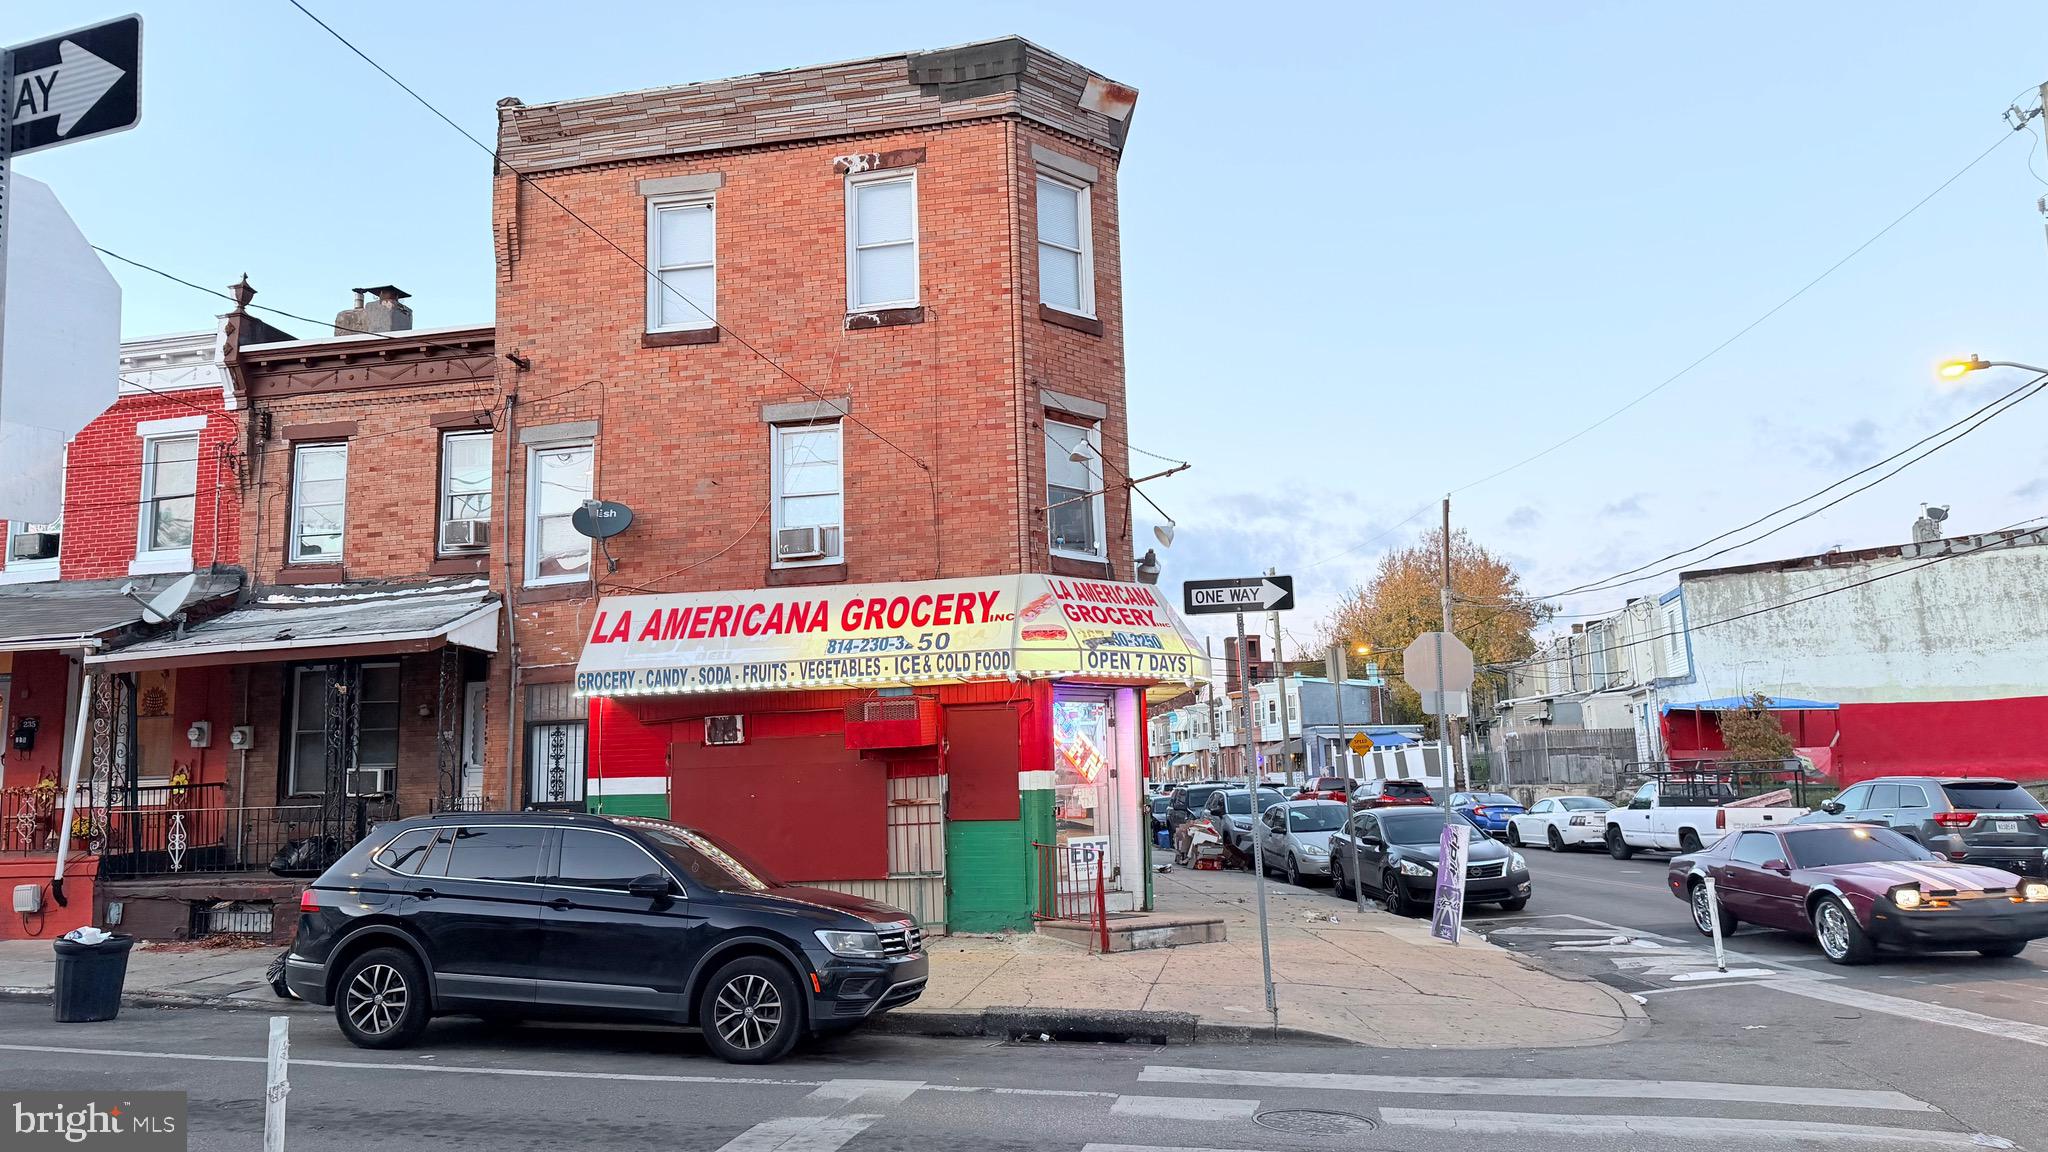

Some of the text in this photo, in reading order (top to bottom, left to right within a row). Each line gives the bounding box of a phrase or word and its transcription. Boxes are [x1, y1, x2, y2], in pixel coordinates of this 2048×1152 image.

[13, 70, 59, 120] AY
[1048, 579, 1159, 607] LA AMERICANA
[1195, 588, 1259, 603] ONE WAY
[590, 590, 1015, 644] LA AMERICANA GROCERY INC
[1063, 603, 1157, 628] GROCERY
[577, 650, 1011, 691] GROCERY CANDY SODA FRUITS VEGETABLES ICE & COLD FOOD
[1088, 651, 1187, 673] OPEN 7 DAYS
[1071, 841, 1107, 863] EBT
